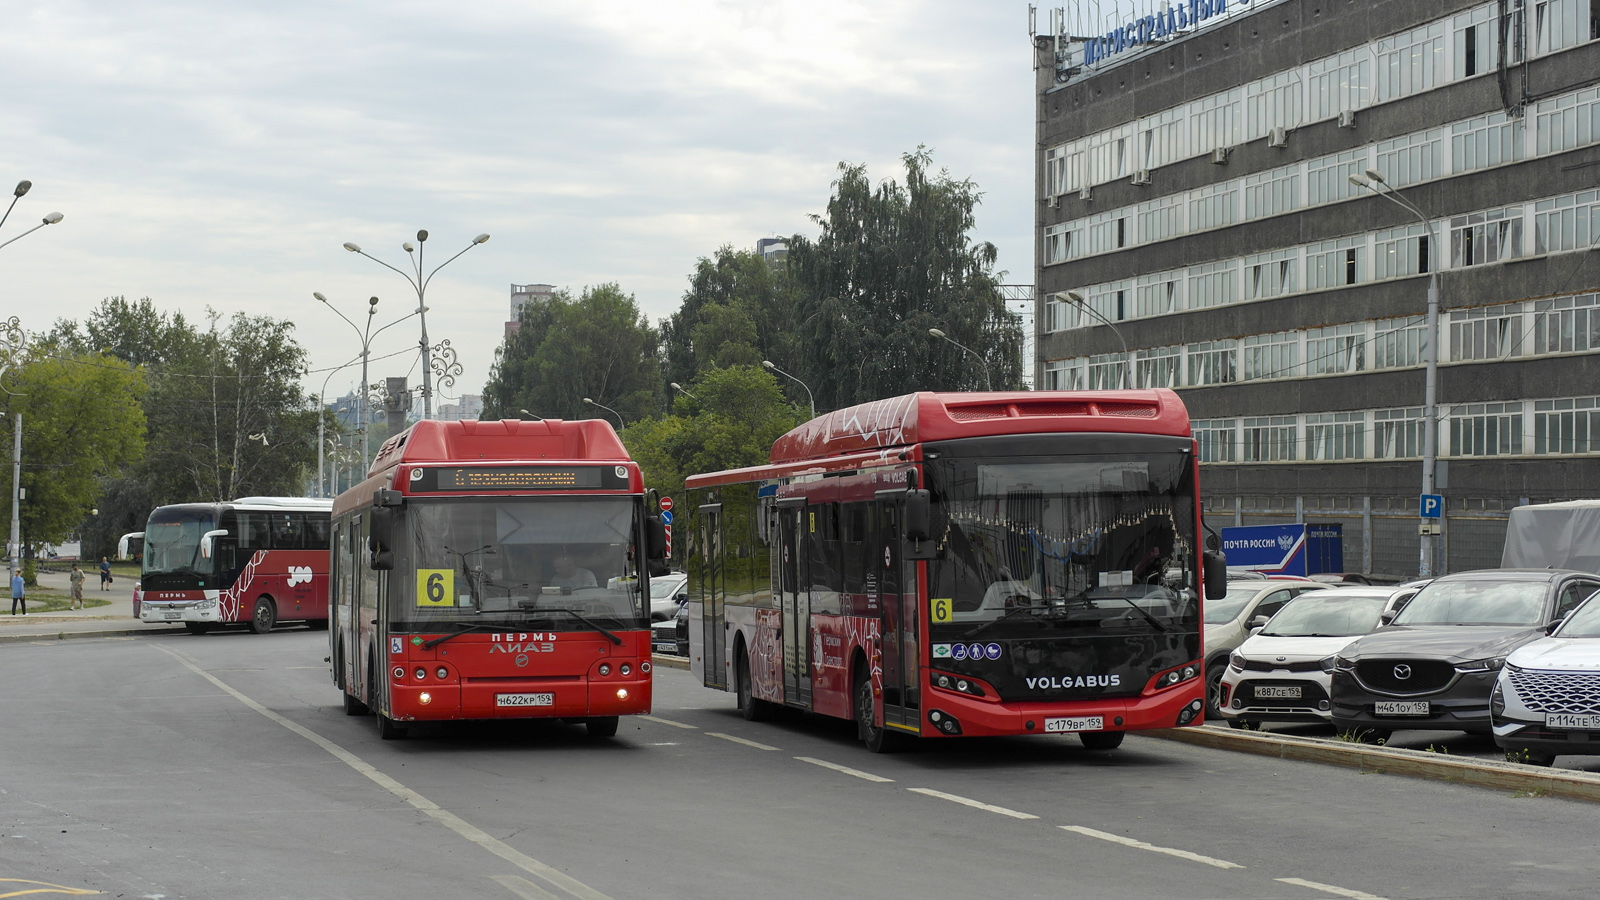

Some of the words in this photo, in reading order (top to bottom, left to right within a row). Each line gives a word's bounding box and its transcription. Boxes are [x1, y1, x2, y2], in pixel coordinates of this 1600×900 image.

[1425, 498, 1437, 514] P
[1224, 540, 1249, 549] ПОЧТА
[1250, 539, 1276, 548] РОССИИ
[426, 572, 445, 603] 6
[935, 600, 947, 620] 6
[492, 633, 557, 642] ПЕРМЬ
[489, 643, 555, 653] ЛИАЗ
[1025, 674, 1121, 690] VOLGABUS
[1288, 687, 1300, 695] 159
[500, 695, 535, 705] Н622КР
[537, 694, 551, 702] 159
[1413, 702, 1427, 710] 159
[1048, 719, 1085, 731] С179ВР
[1086, 718, 1101, 726] 159
